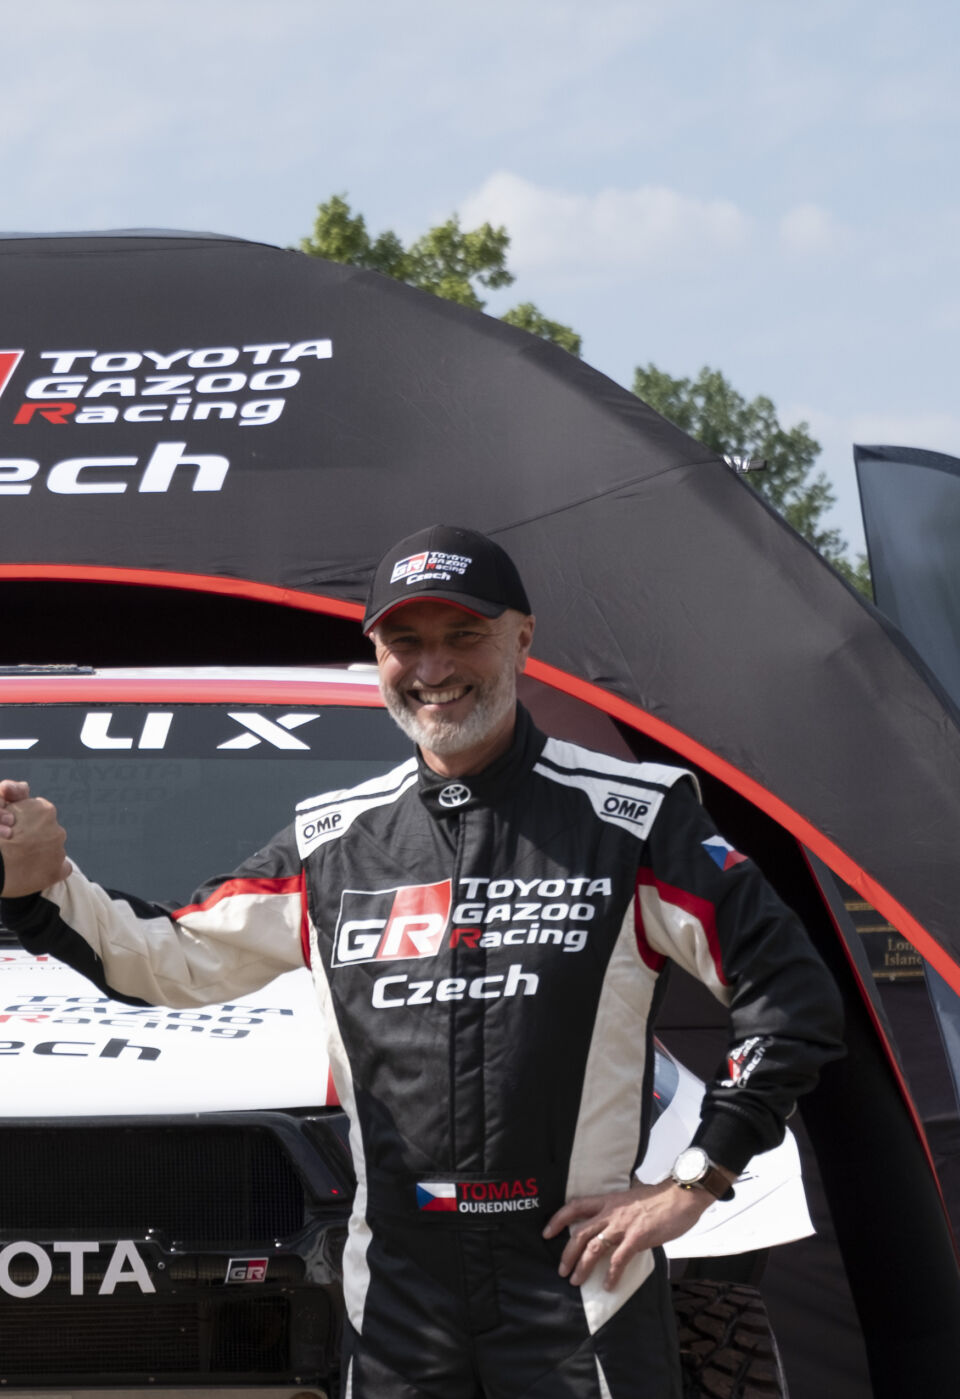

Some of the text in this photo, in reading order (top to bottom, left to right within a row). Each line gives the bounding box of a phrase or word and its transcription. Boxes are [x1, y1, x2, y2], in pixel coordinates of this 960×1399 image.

[40, 339, 333, 374] TOYOTA
[25, 369, 300, 399] GAZOO
[13, 398, 286, 426] Racing
[425, 563, 466, 574] Racing
[428, 557, 468, 568] GAZOO
[430, 551, 472, 564] TOYOTA
[406, 572, 451, 585] Czech
[604, 796, 649, 819] OMP
[303, 813, 342, 839] OMP
[459, 876, 613, 898] TOYOTA
[452, 902, 596, 924] GAZOO
[338, 915, 448, 962] GR
[449, 923, 589, 953] Racing
[371, 963, 540, 1010] Czech
[4, 1004, 264, 1025] GAZOO
[16, 995, 294, 1016] TOTA
[458, 1178, 538, 1201] TOMAS
[458, 1198, 539, 1213] OUREDNICEK
